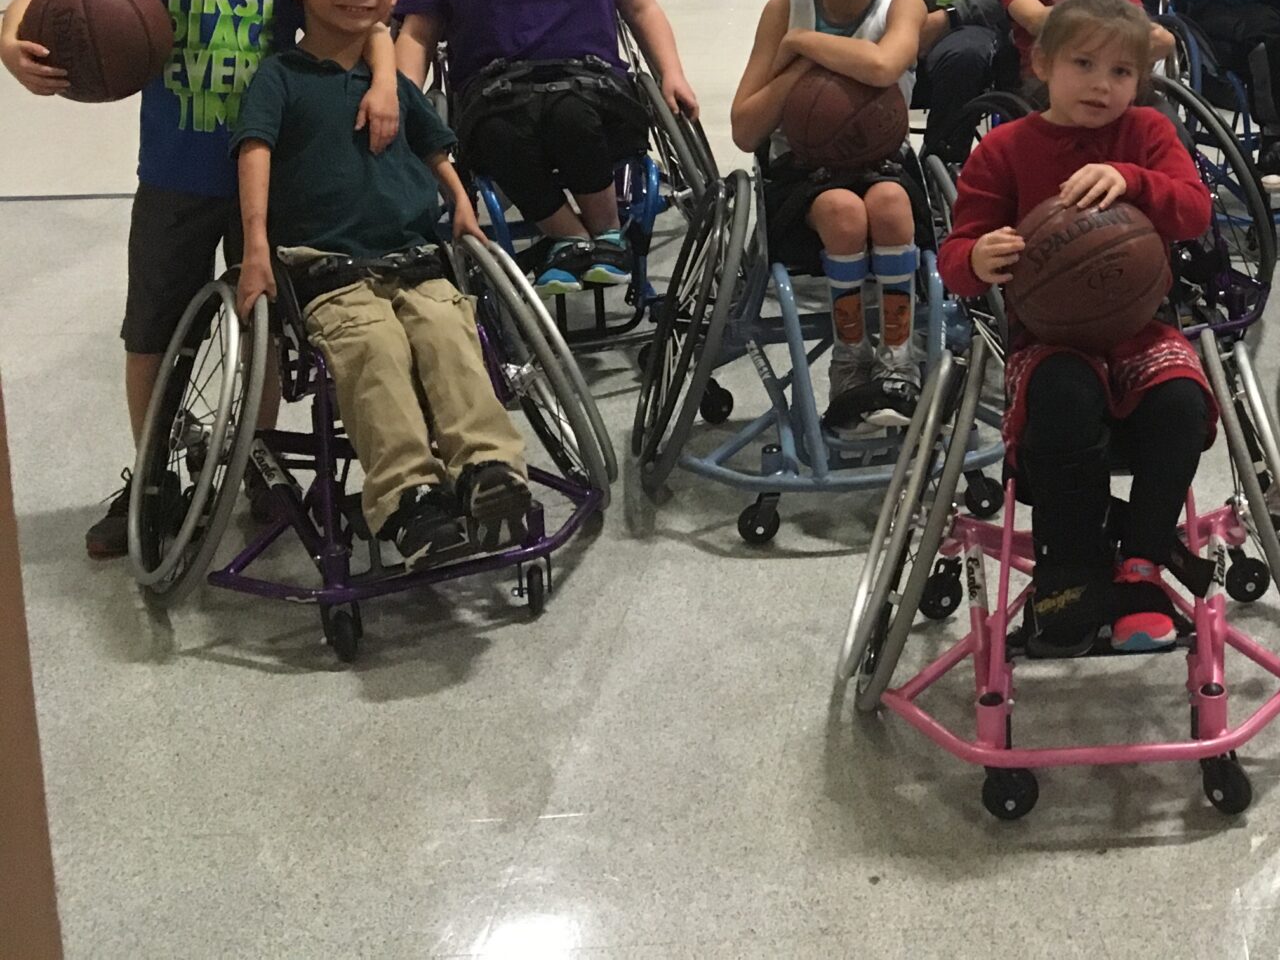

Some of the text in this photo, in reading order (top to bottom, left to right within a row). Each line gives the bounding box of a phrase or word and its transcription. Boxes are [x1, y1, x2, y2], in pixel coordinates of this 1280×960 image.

[163, 49, 262, 93] EVER
[173, 86, 243, 134] TIM
[1026, 207, 1136, 273] SPALDING
